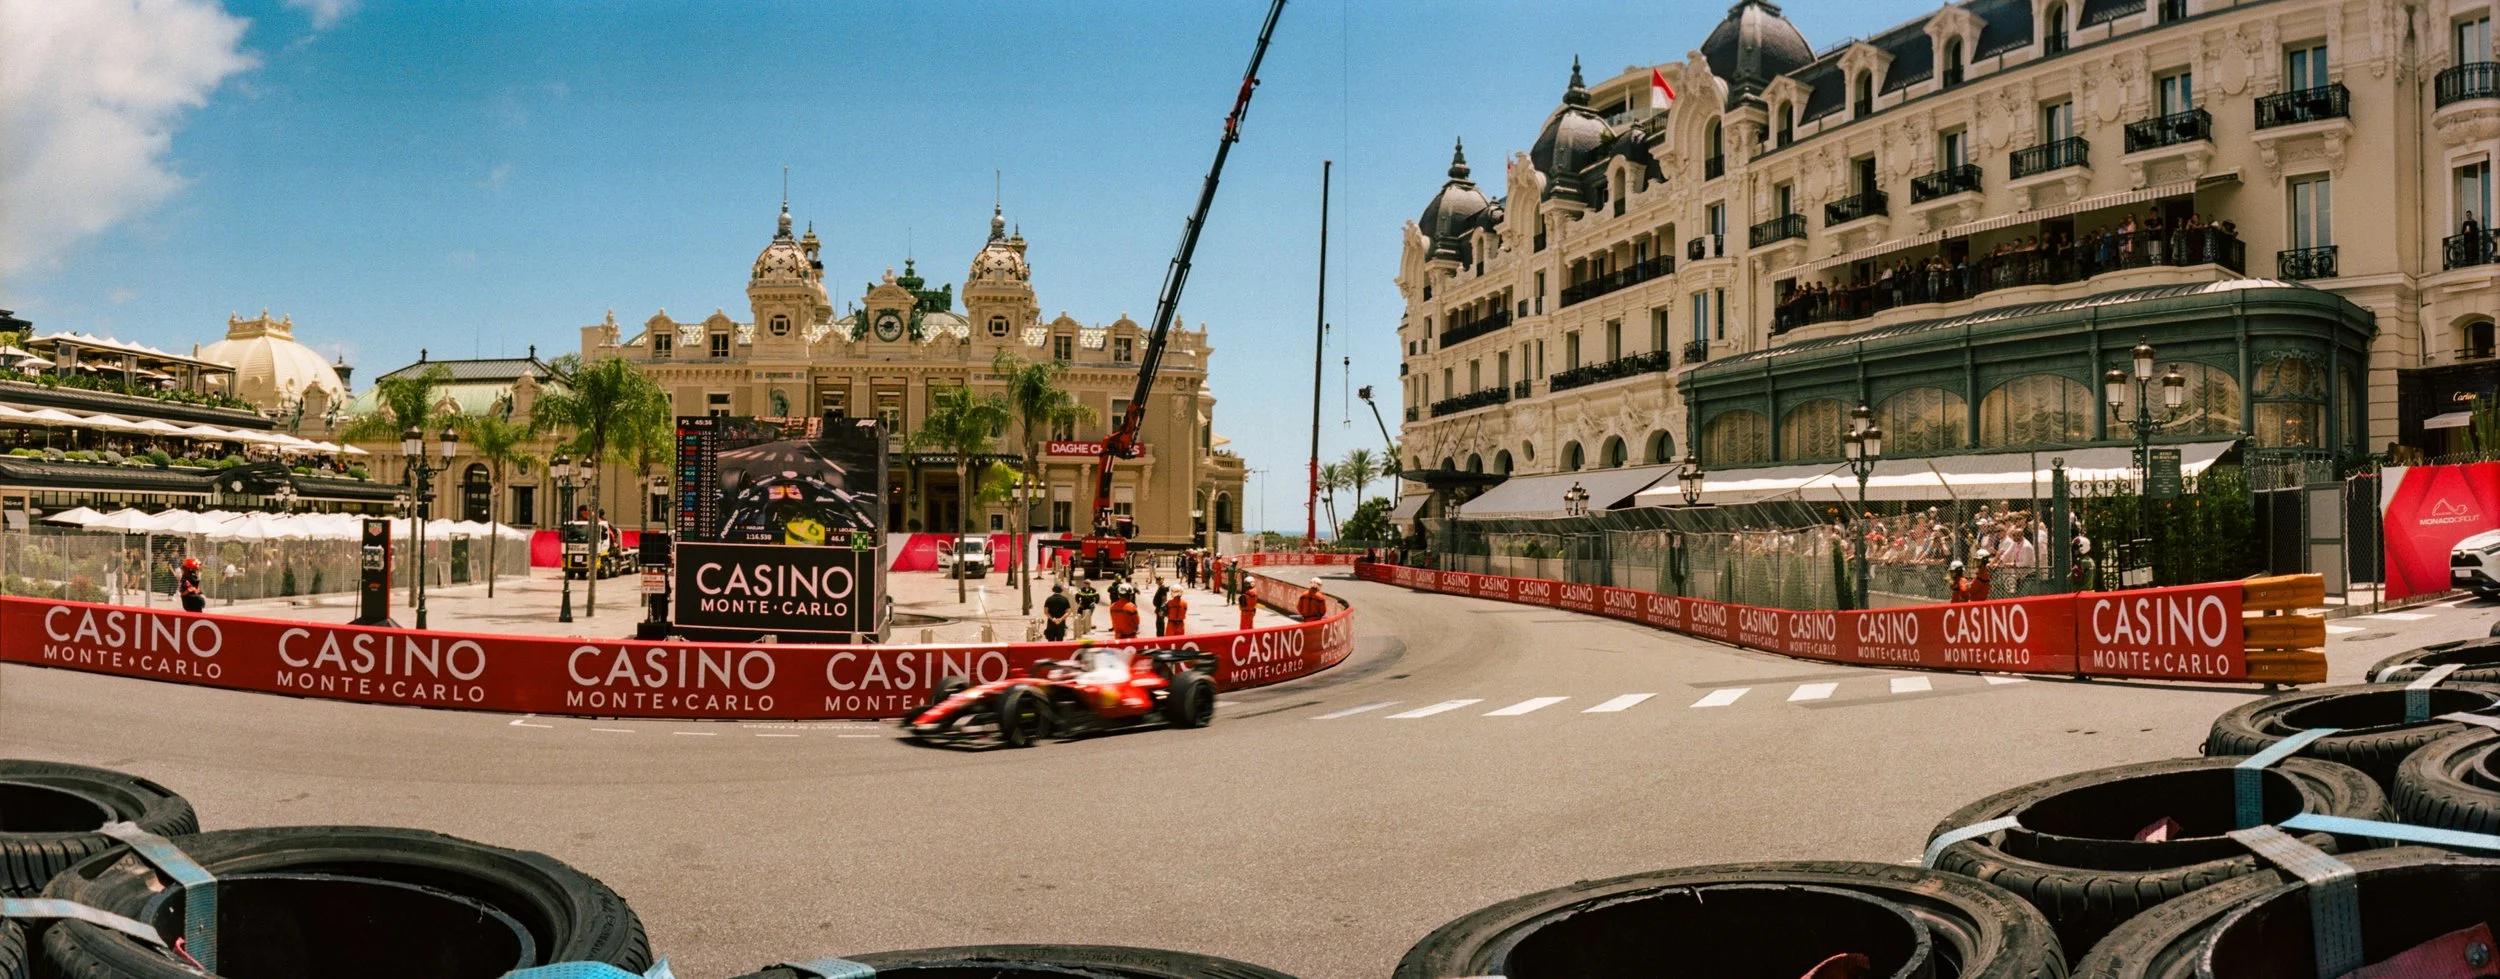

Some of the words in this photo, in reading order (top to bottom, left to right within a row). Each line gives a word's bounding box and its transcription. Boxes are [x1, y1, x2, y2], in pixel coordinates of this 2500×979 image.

[1051, 443, 1088, 453] DAGHE
[696, 562, 854, 599] CASINO
[1442, 573, 1470, 587] CASINO
[1479, 576, 1509, 592] CASINO
[1519, 580, 1550, 597] CASINO
[1560, 584, 1593, 602] CASINO
[1604, 589, 1637, 609] CASINO
[701, 598, 769, 614] MONTE
[782, 601, 848, 616] CARLO
[1604, 606, 1620, 616] MONTE
[1622, 608, 1637, 618] CARLO
[1647, 595, 1681, 618] CASINO
[1691, 602, 1727, 626] CASINO
[44, 606, 222, 658] CASINO
[1647, 614, 1663, 625] MONTE
[1665, 616, 1681, 628] CARLO
[1691, 623, 1708, 634] MONTE
[1710, 626, 1727, 638] CARLO
[1739, 609, 1779, 636] CASINO
[1789, 614, 1836, 641] CASINO
[1858, 612, 1919, 645] CASINO
[1943, 604, 2029, 644] CASINO
[2092, 594, 2228, 648] CASINO
[1231, 629, 1304, 667] CASINO
[1740, 633, 1758, 644] MONTE
[1761, 636, 1779, 649] CARLO
[1790, 641, 1810, 653] MONTE
[1813, 643, 1837, 656] CARLO
[44, 645, 121, 669] MONTE
[140, 655, 221, 680] CARLO
[279, 628, 486, 681] CASINO
[1858, 646, 1885, 660] MONTE
[1889, 648, 1920, 663] CARLO
[1944, 648, 1981, 663] MONTE
[1989, 649, 2030, 664] CARLO
[2094, 650, 2150, 671] MONTE
[2164, 652, 2230, 676] CARLO
[568, 646, 776, 691] CASINO
[826, 651, 1008, 691] CASINO
[1231, 665, 1269, 684] MONTE
[1276, 659, 1304, 676] CARLO
[277, 670, 371, 695] MONTE
[392, 680, 485, 703] CARLO
[567, 691, 664, 710] MONTE
[685, 693, 774, 712] CARLO
[825, 695, 912, 713] MONTE
